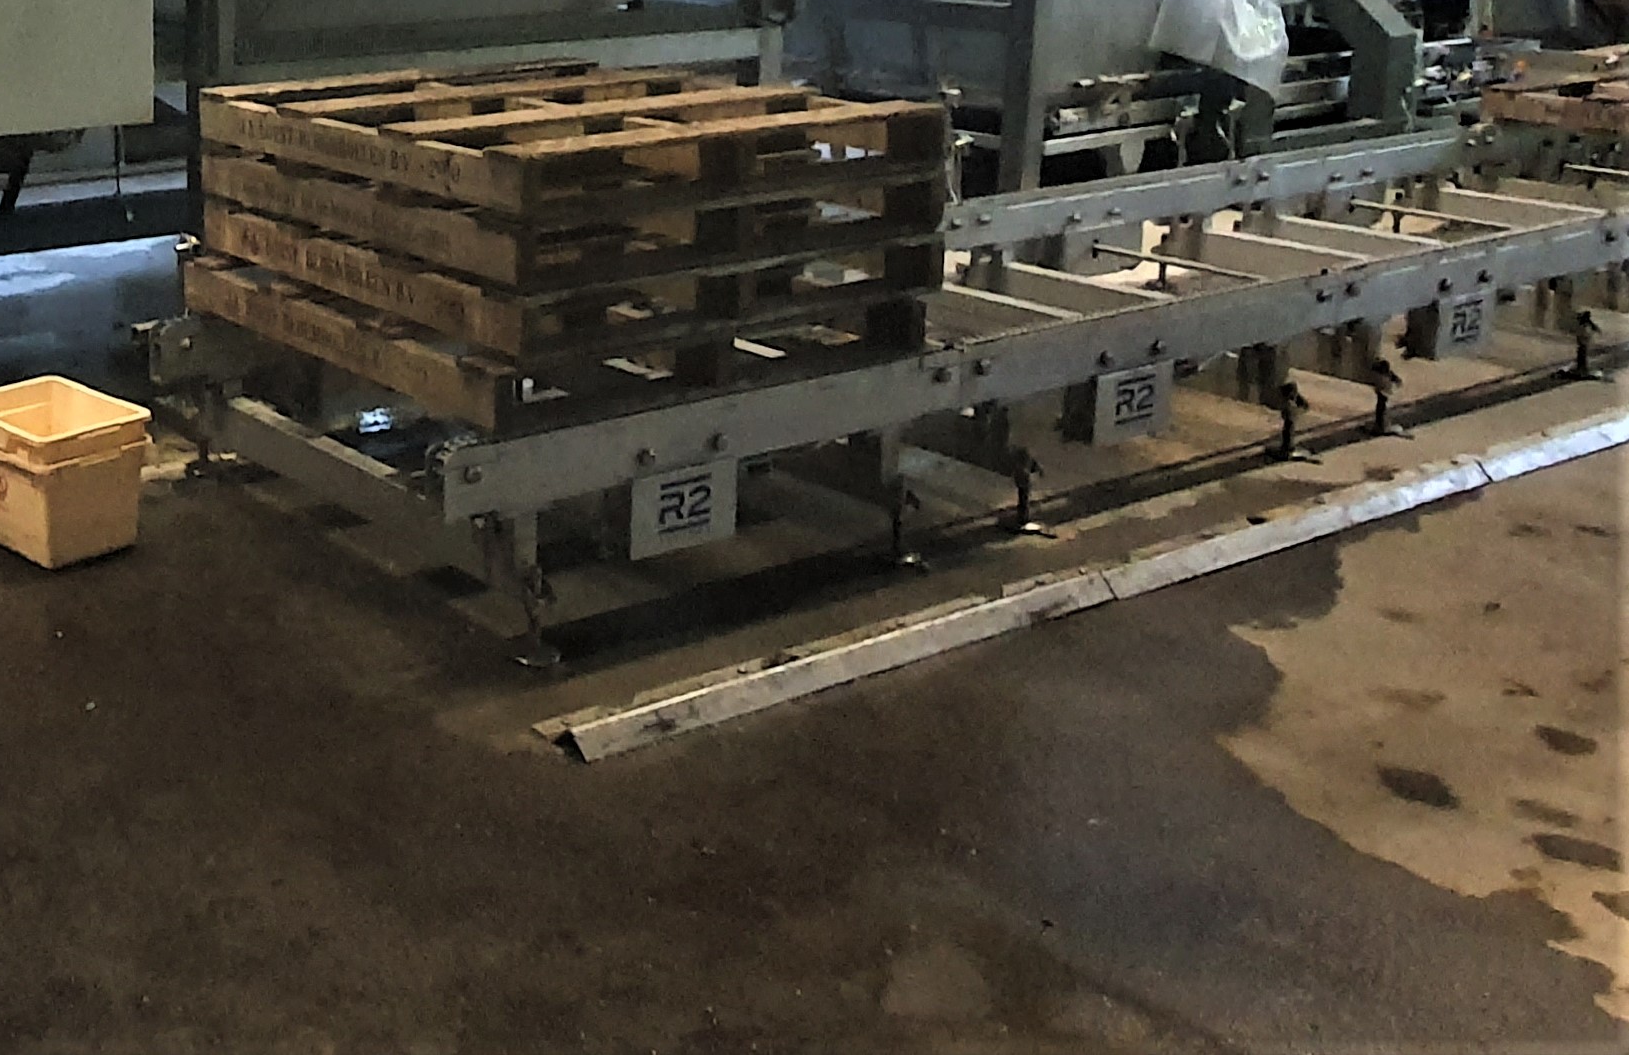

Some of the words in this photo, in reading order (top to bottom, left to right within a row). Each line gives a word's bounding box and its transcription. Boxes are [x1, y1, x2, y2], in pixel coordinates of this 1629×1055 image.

[1451, 307, 1481, 335] R2
[1115, 384, 1154, 416] R2
[658, 484, 712, 525] R2
